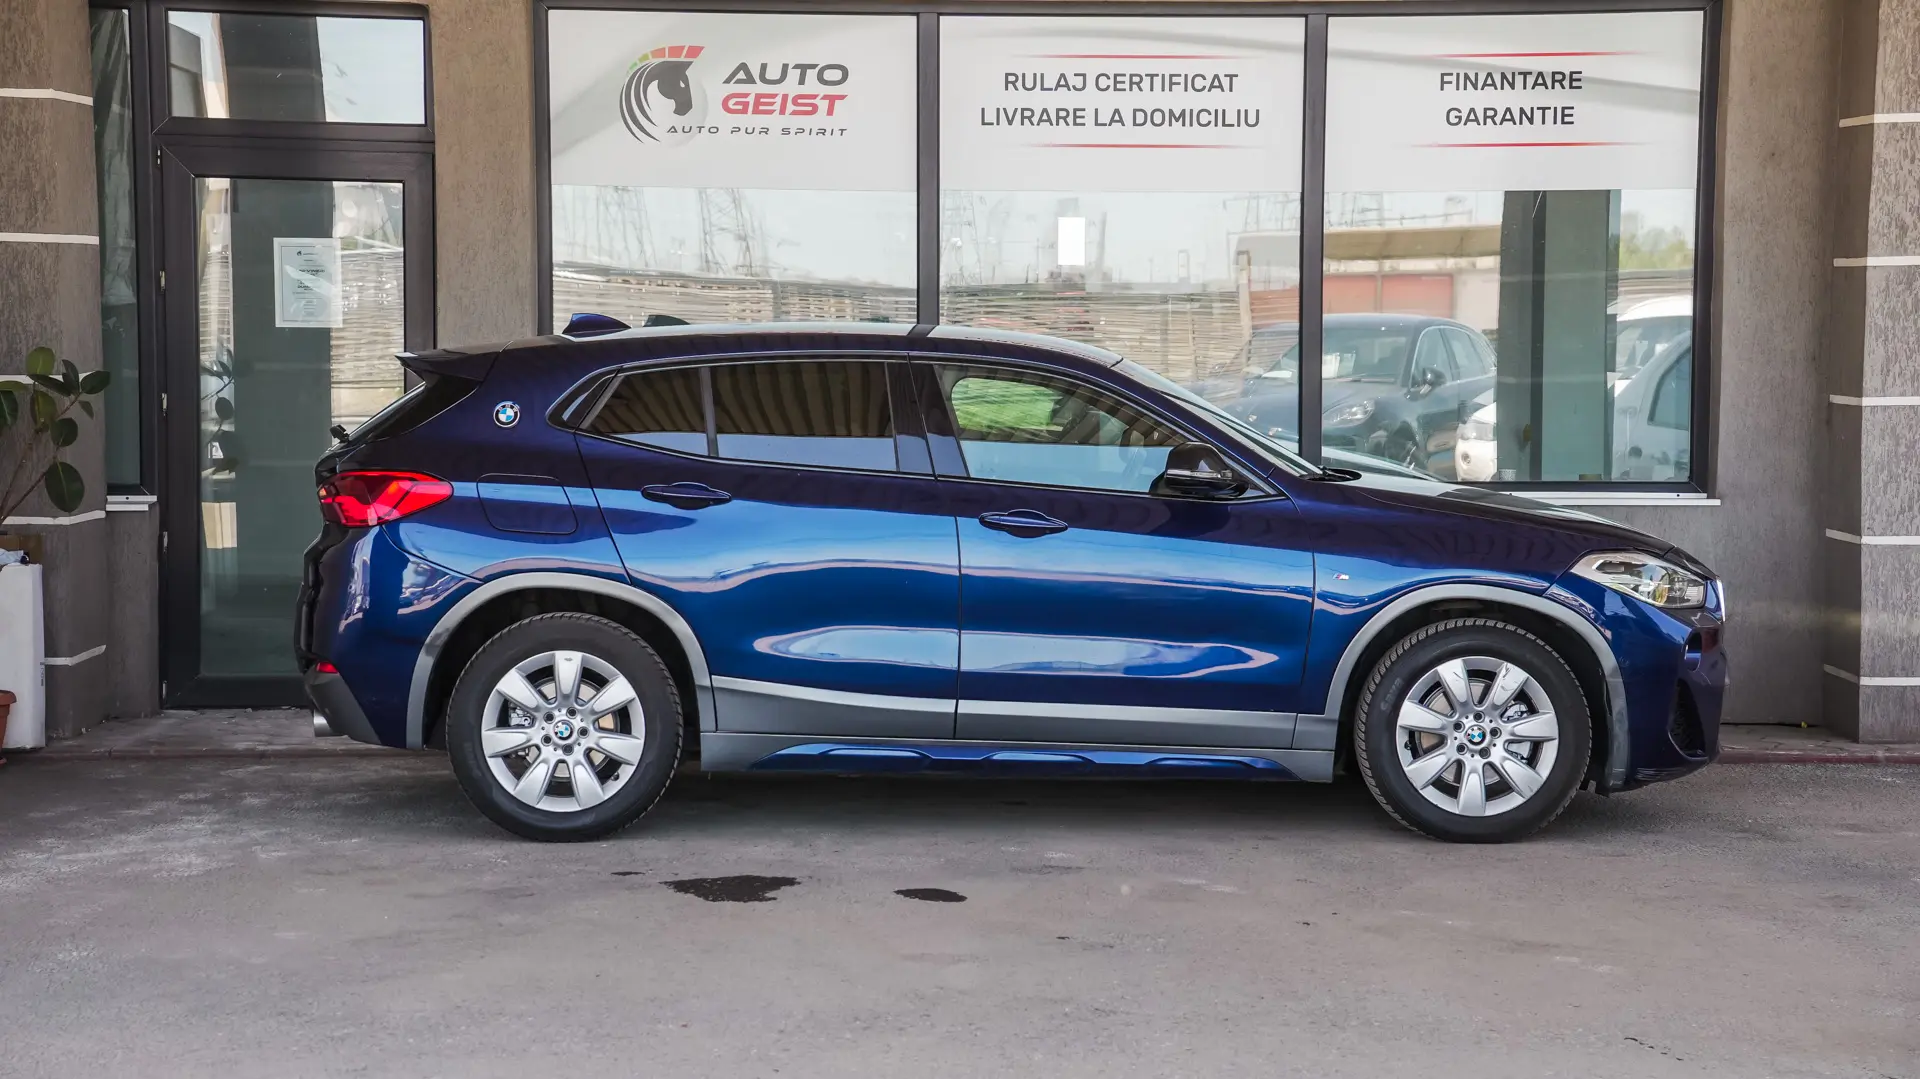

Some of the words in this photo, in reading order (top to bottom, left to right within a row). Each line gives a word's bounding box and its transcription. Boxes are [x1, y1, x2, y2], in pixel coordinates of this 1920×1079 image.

[722, 62, 849, 87] AUTO
[1003, 72, 1088, 92] RULAJ
[1094, 73, 1239, 93] CERTIFICAT
[1440, 71, 1583, 91] FINANTARE
[721, 92, 849, 117] GEIST
[980, 107, 1086, 126] LIVRARE
[1093, 108, 1126, 127] LA
[1132, 108, 1260, 128] DOMICILIU
[1445, 106, 1575, 126] GARANTIE
[666, 125, 720, 135] AUTO
[730, 126, 770, 136] PUR
[780, 127, 848, 137] SPIRIT
